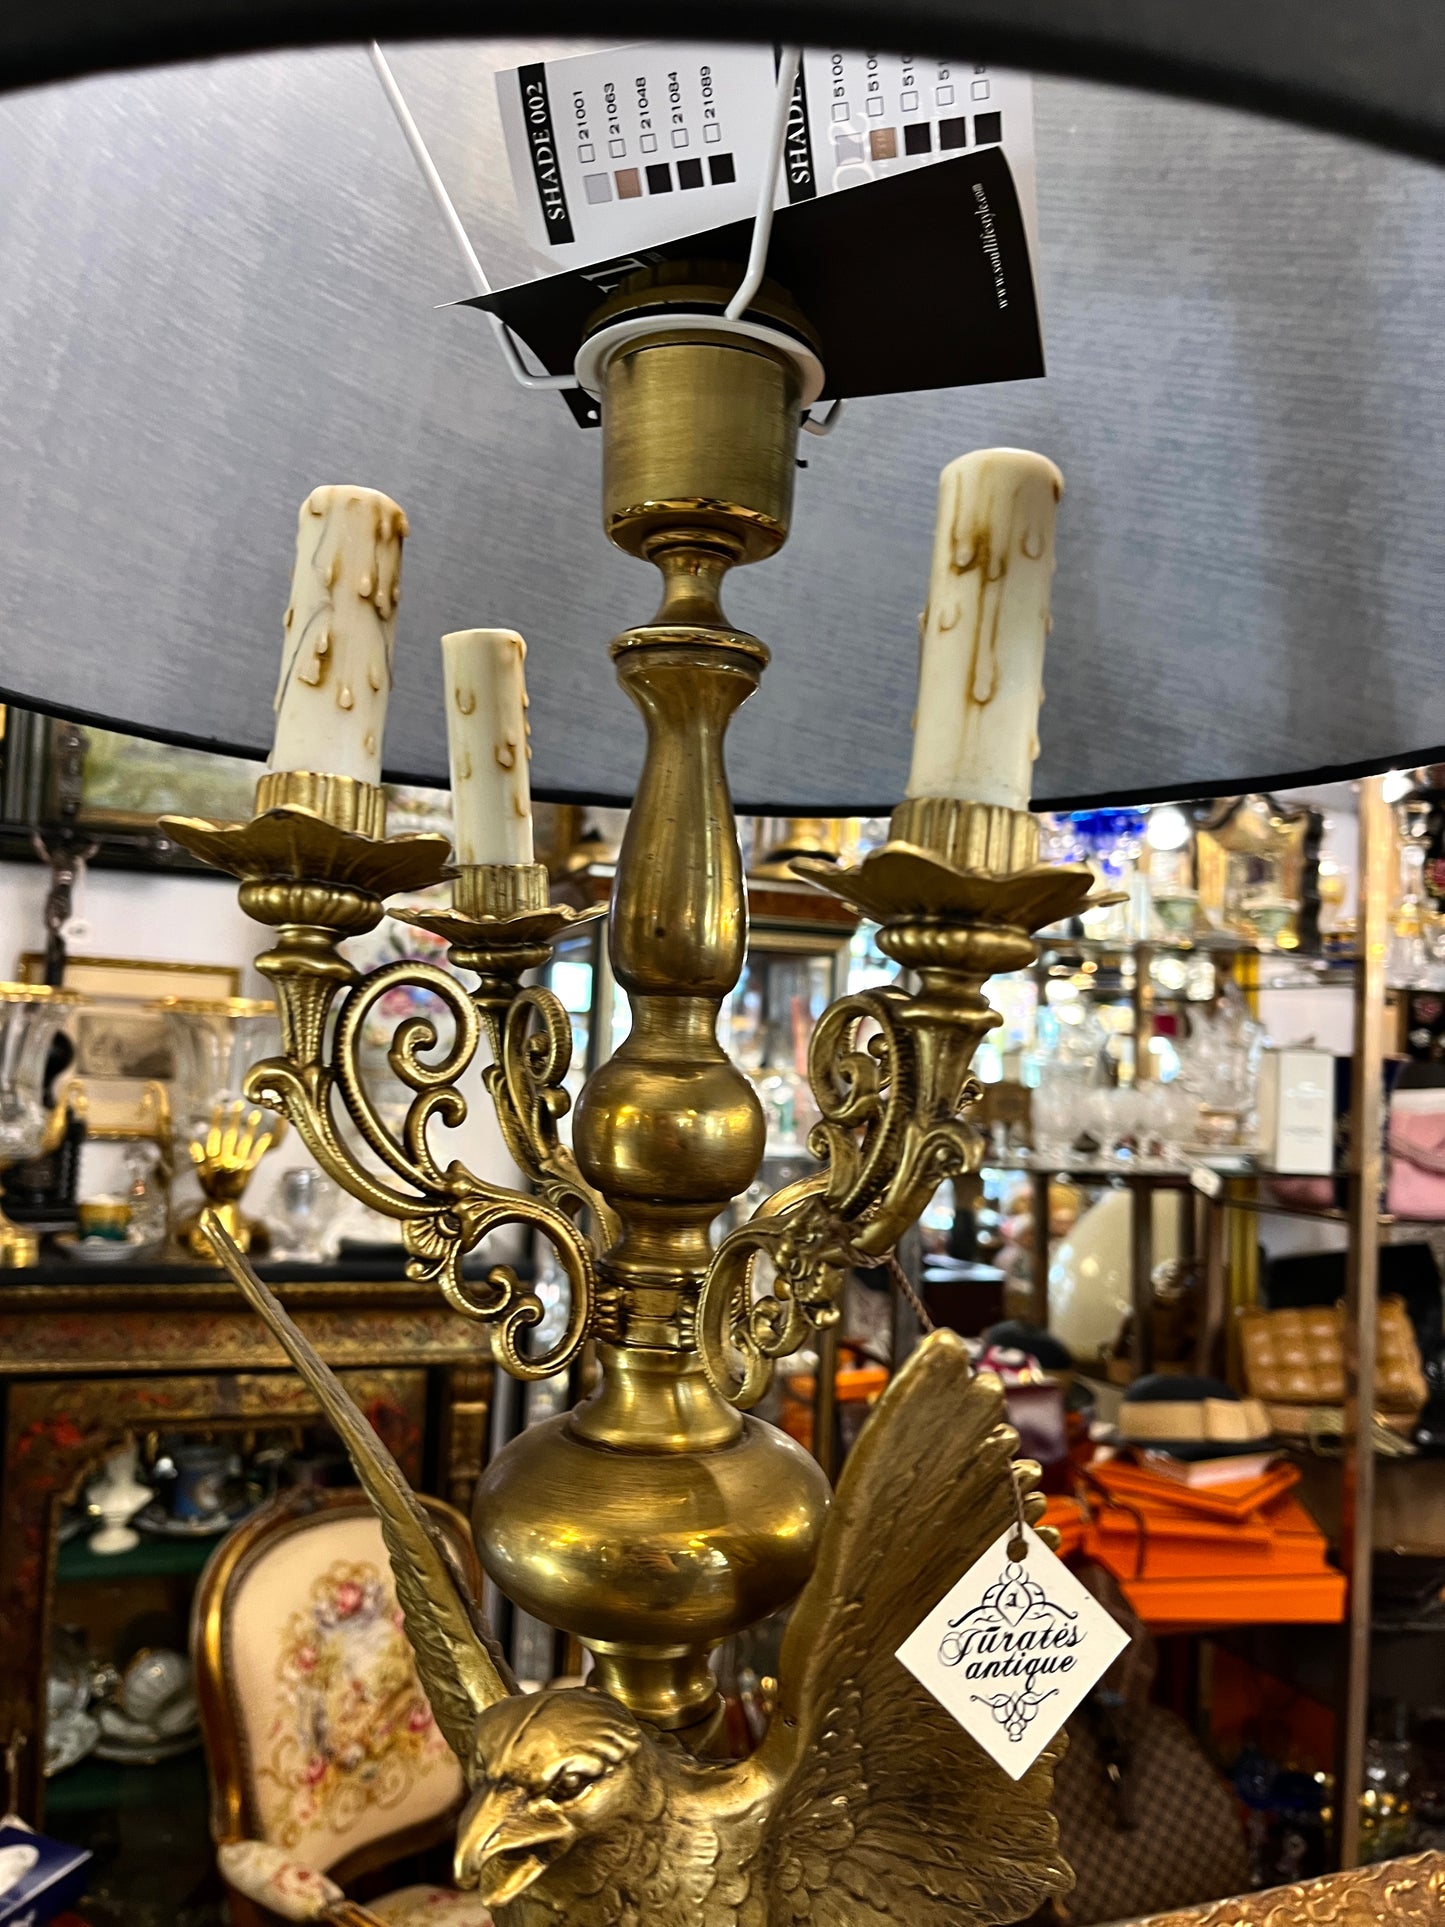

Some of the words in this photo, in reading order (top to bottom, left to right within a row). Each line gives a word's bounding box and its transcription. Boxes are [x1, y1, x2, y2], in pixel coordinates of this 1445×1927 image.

[668, 71, 684, 124] 21084
[700, 65, 716, 119] 21089
[831, 52, 845, 97] 5100
[526, 81, 548, 124] 002
[573, 90, 590, 140] 21001
[603, 82, 620, 135] 21063
[636, 76, 652, 129] 21048
[532, 130, 565, 220] SHADE
[972, 183, 1008, 309] www.soullifestyle.com
[965, 1651, 1077, 1692] antique
